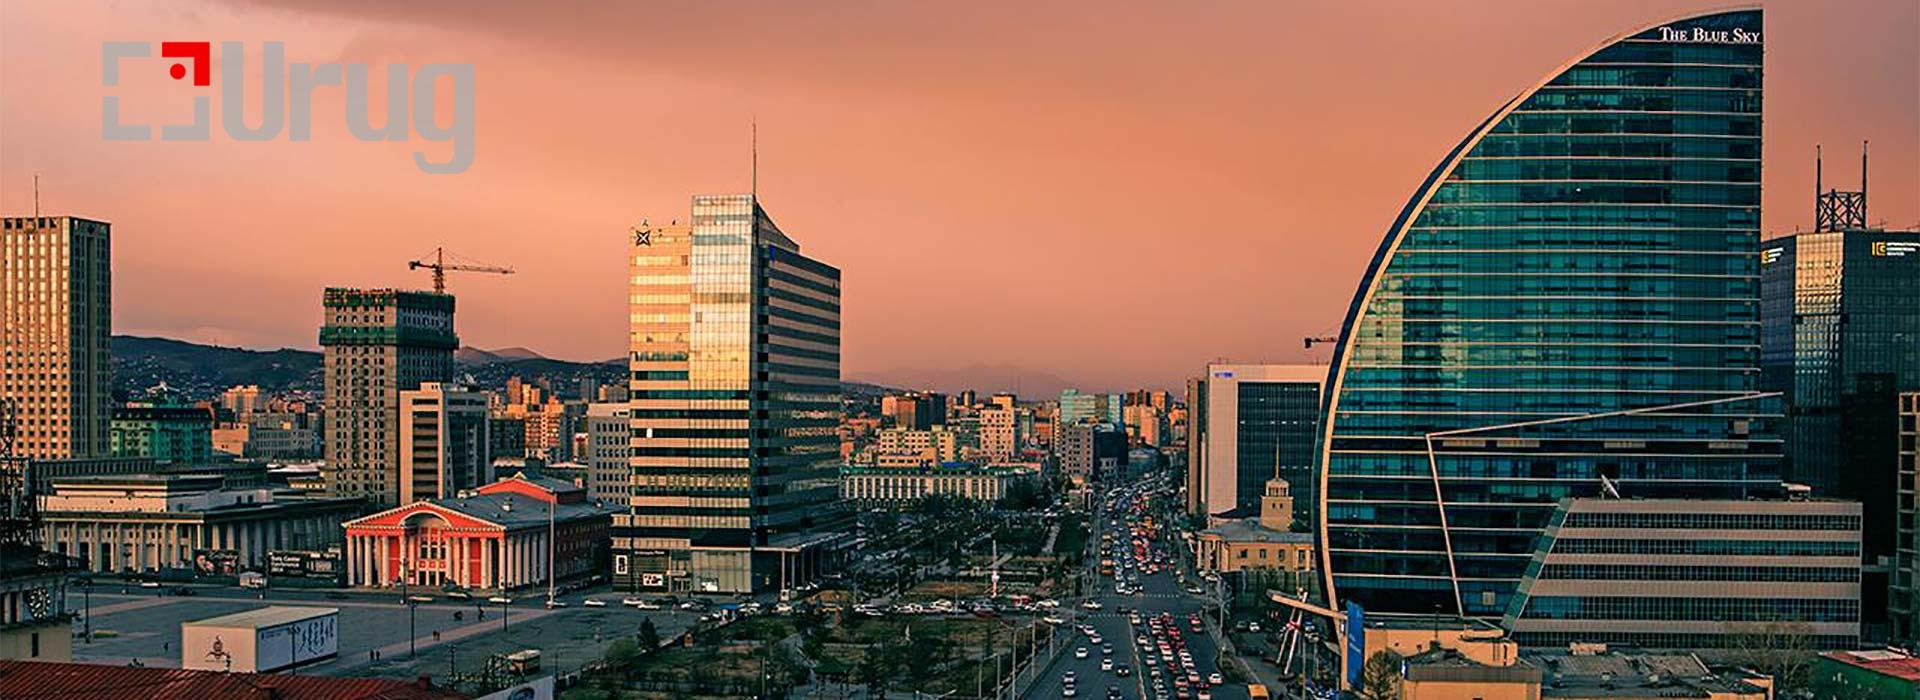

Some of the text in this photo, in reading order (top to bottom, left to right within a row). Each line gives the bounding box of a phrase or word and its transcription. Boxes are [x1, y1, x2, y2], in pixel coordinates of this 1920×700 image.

[1658, 26, 1760, 43] THE BLUE SKY
